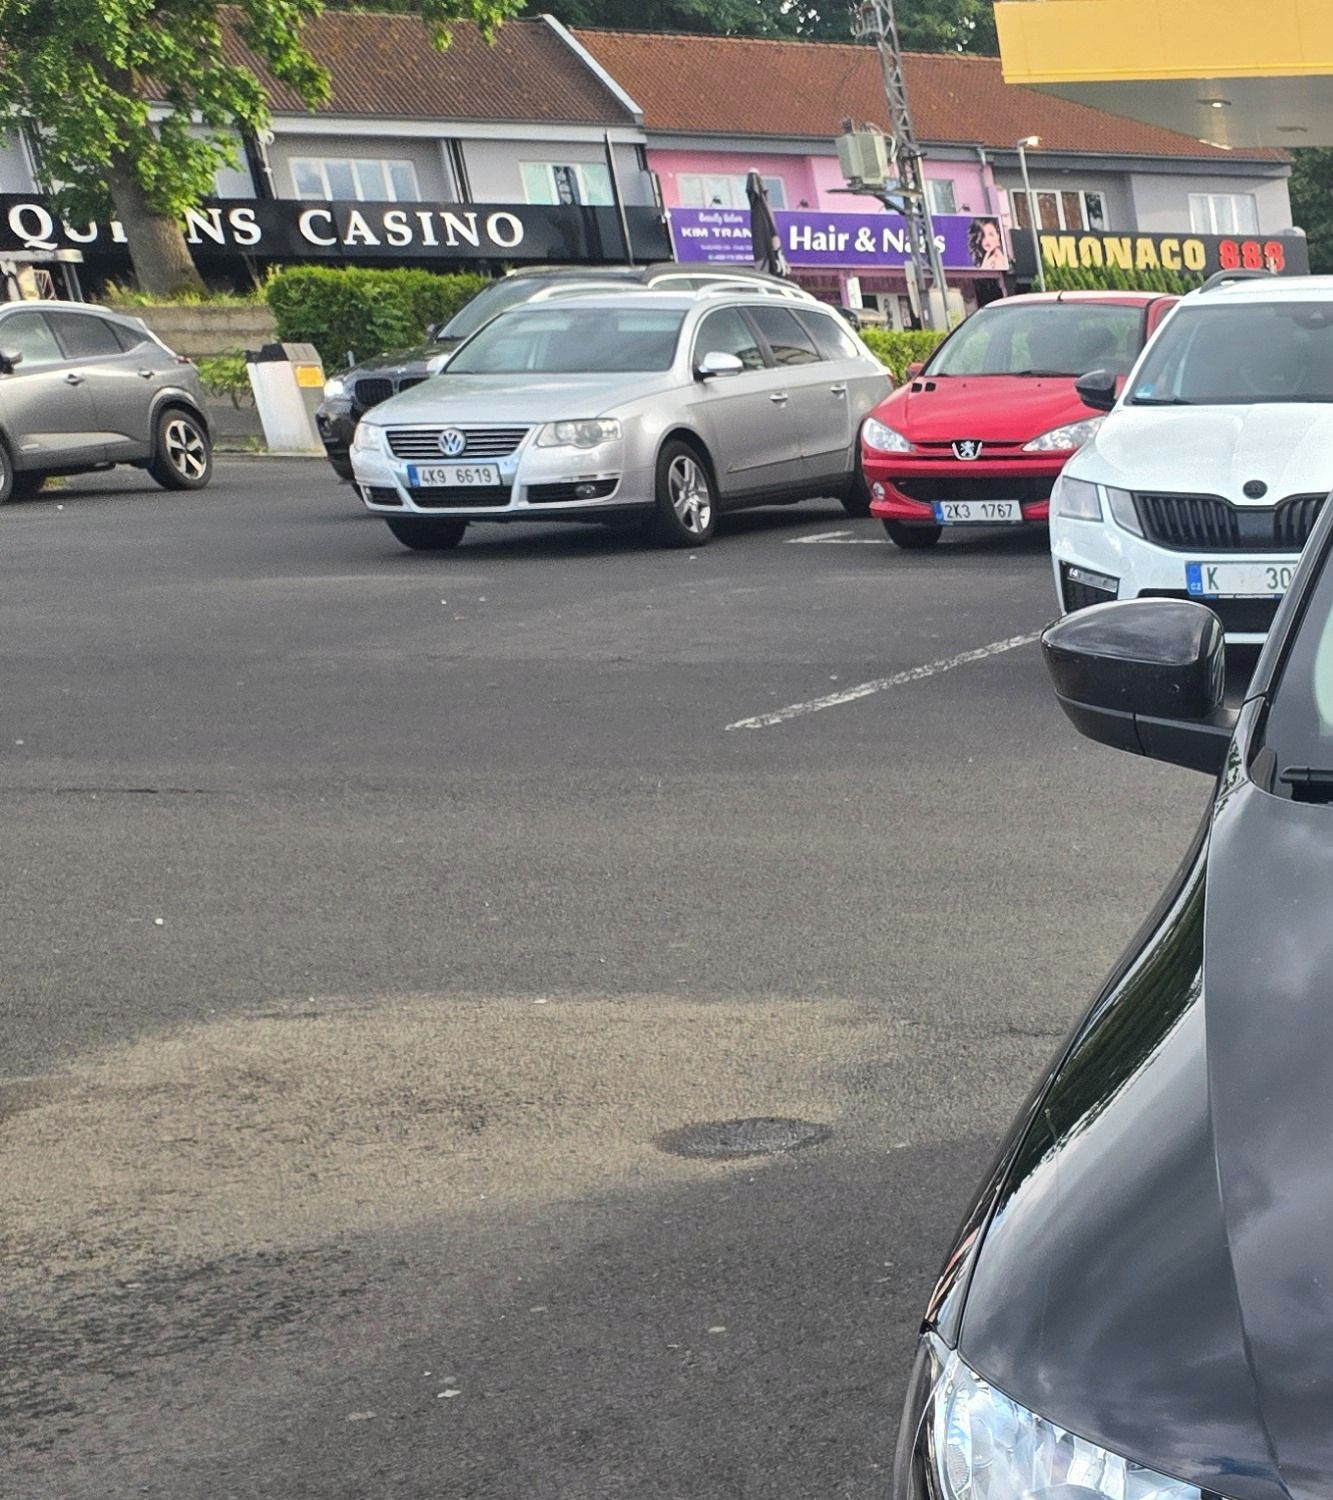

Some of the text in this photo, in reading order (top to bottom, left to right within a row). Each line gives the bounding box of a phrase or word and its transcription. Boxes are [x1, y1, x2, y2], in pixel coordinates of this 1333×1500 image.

[8, 203, 524, 250] QUNS CASINO
[681, 227, 708, 238] KIM
[789, 224, 849, 251] Hair
[854, 226, 876, 252] &
[1039, 235, 1286, 272] MONACO 888
[456, 468, 492, 484] 6619
[944, 503, 1013, 519] 2K3 1767
[1207, 567, 1294, 590] K 30
